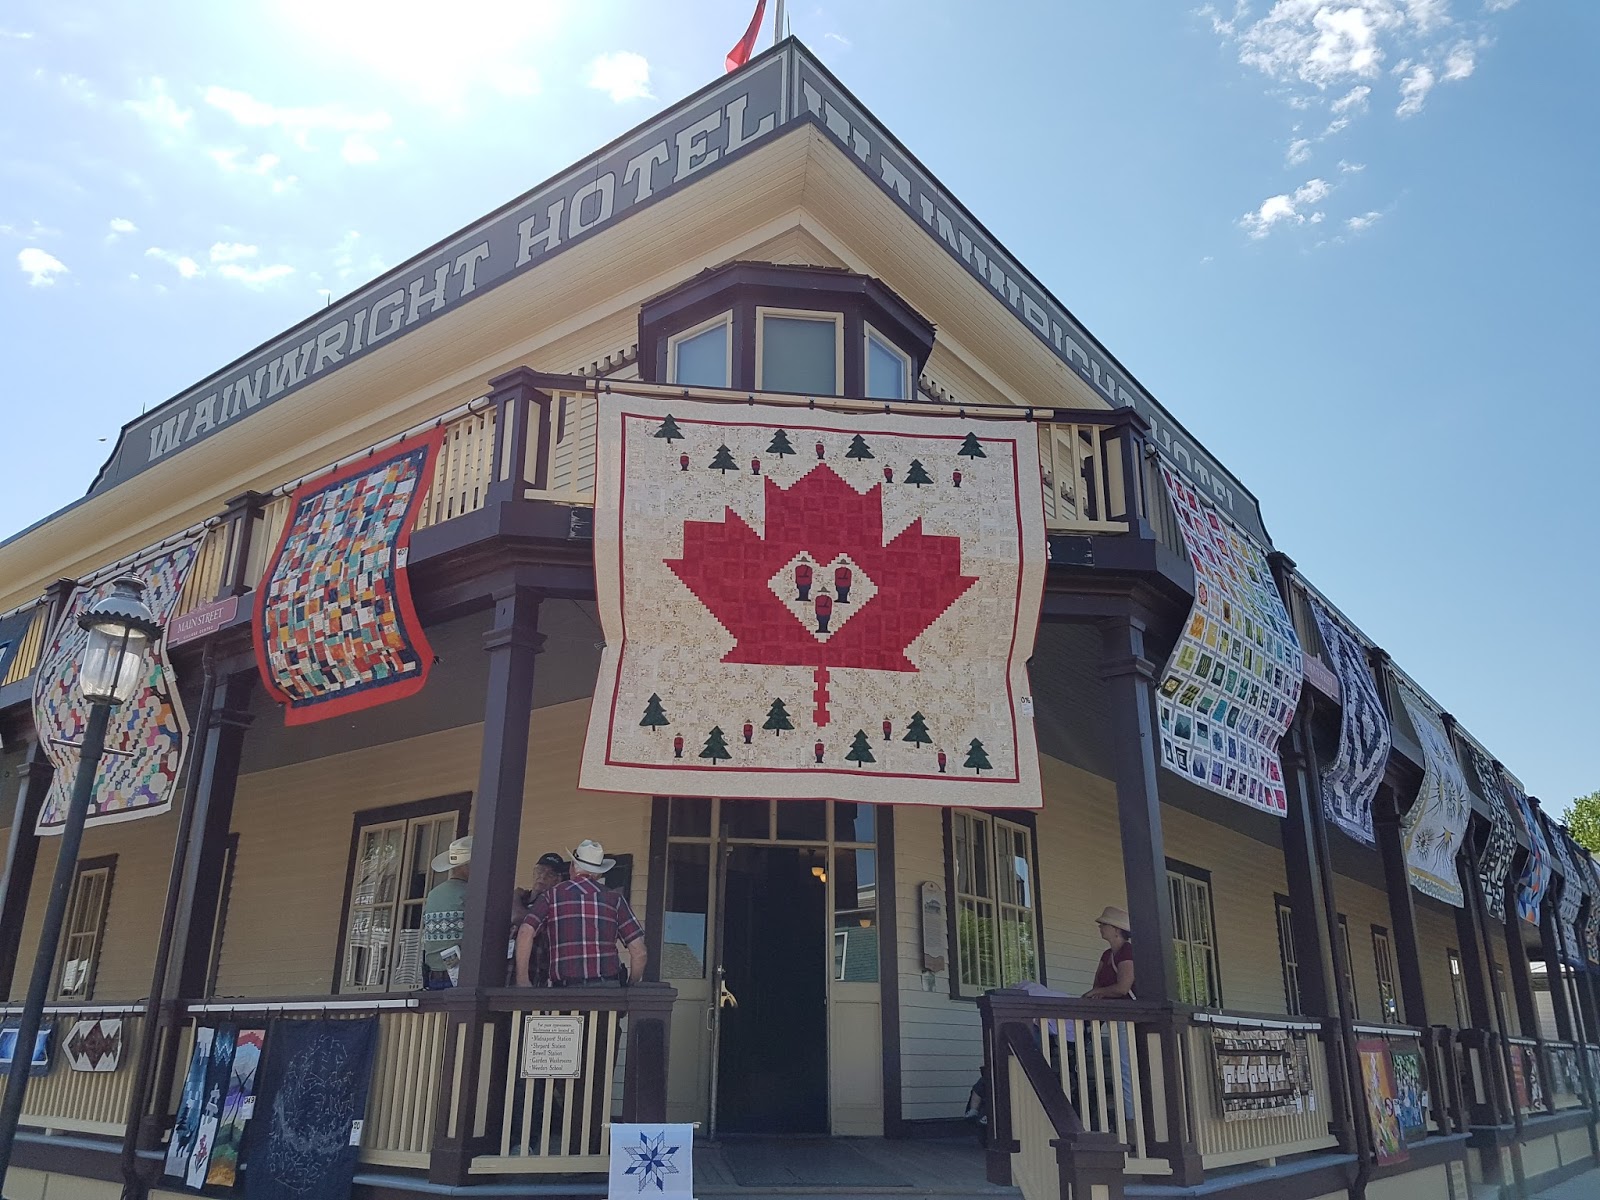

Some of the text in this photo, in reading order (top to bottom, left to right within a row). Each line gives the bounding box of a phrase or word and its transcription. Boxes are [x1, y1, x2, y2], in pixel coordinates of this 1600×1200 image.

[147, 94, 776, 463] WAINWRIGHT HOTEL
[177, 607, 224, 634] MAIN STREET
